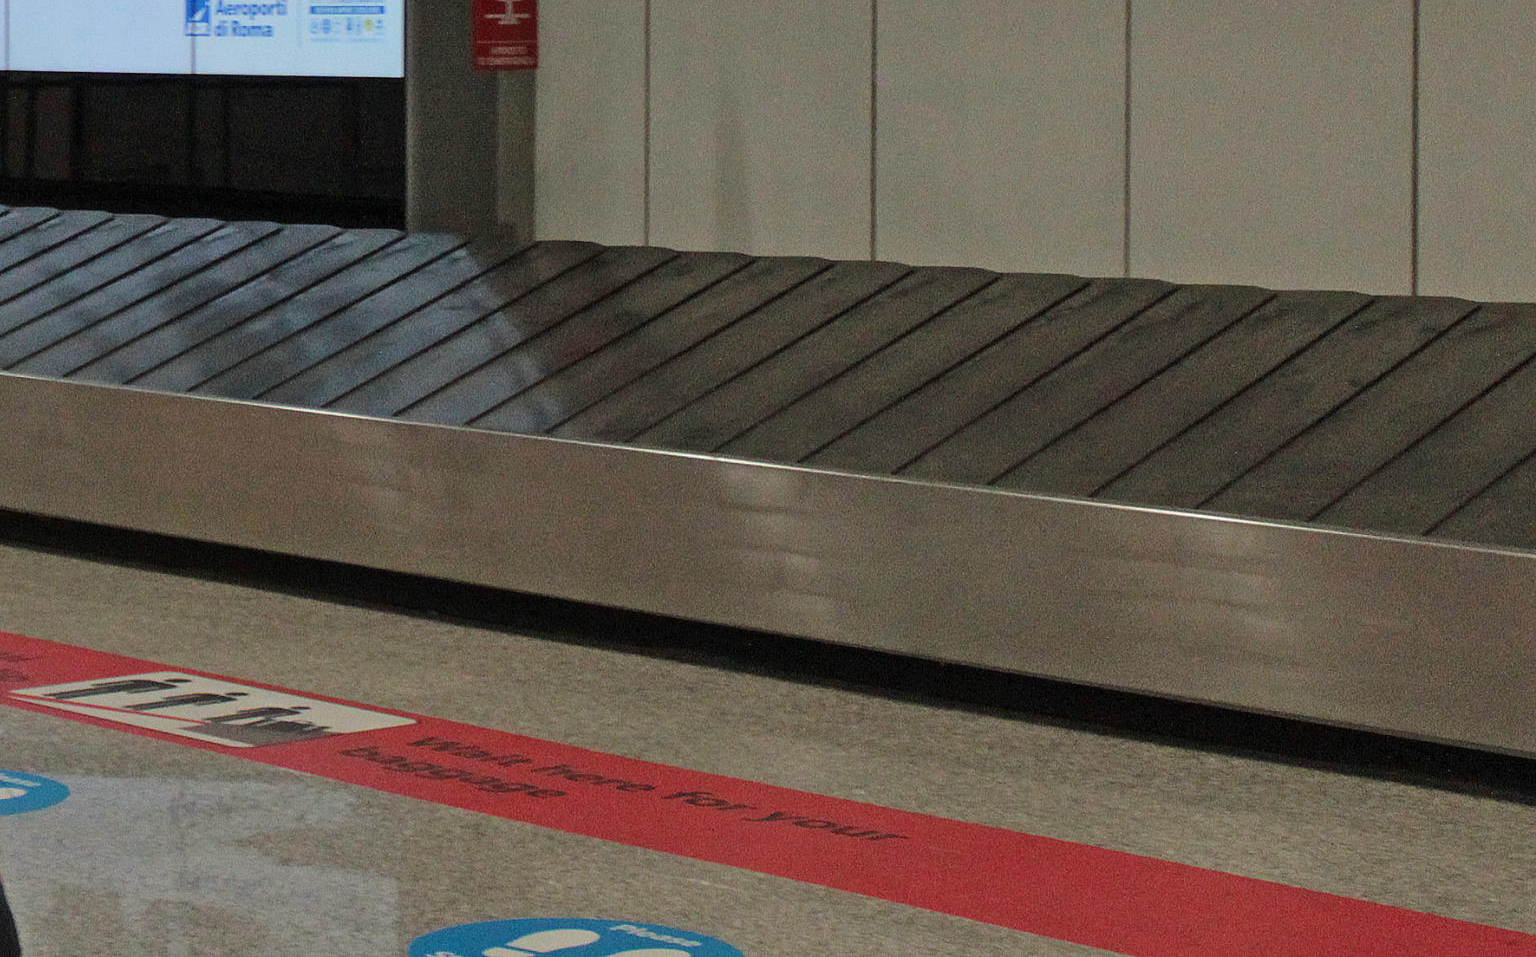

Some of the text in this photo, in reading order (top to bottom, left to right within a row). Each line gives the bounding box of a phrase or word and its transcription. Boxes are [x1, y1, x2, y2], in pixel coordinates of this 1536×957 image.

[214, 22, 274, 38] di Roma
[340, 746, 568, 800] baggage
[406, 736, 910, 842] Wait here for your
